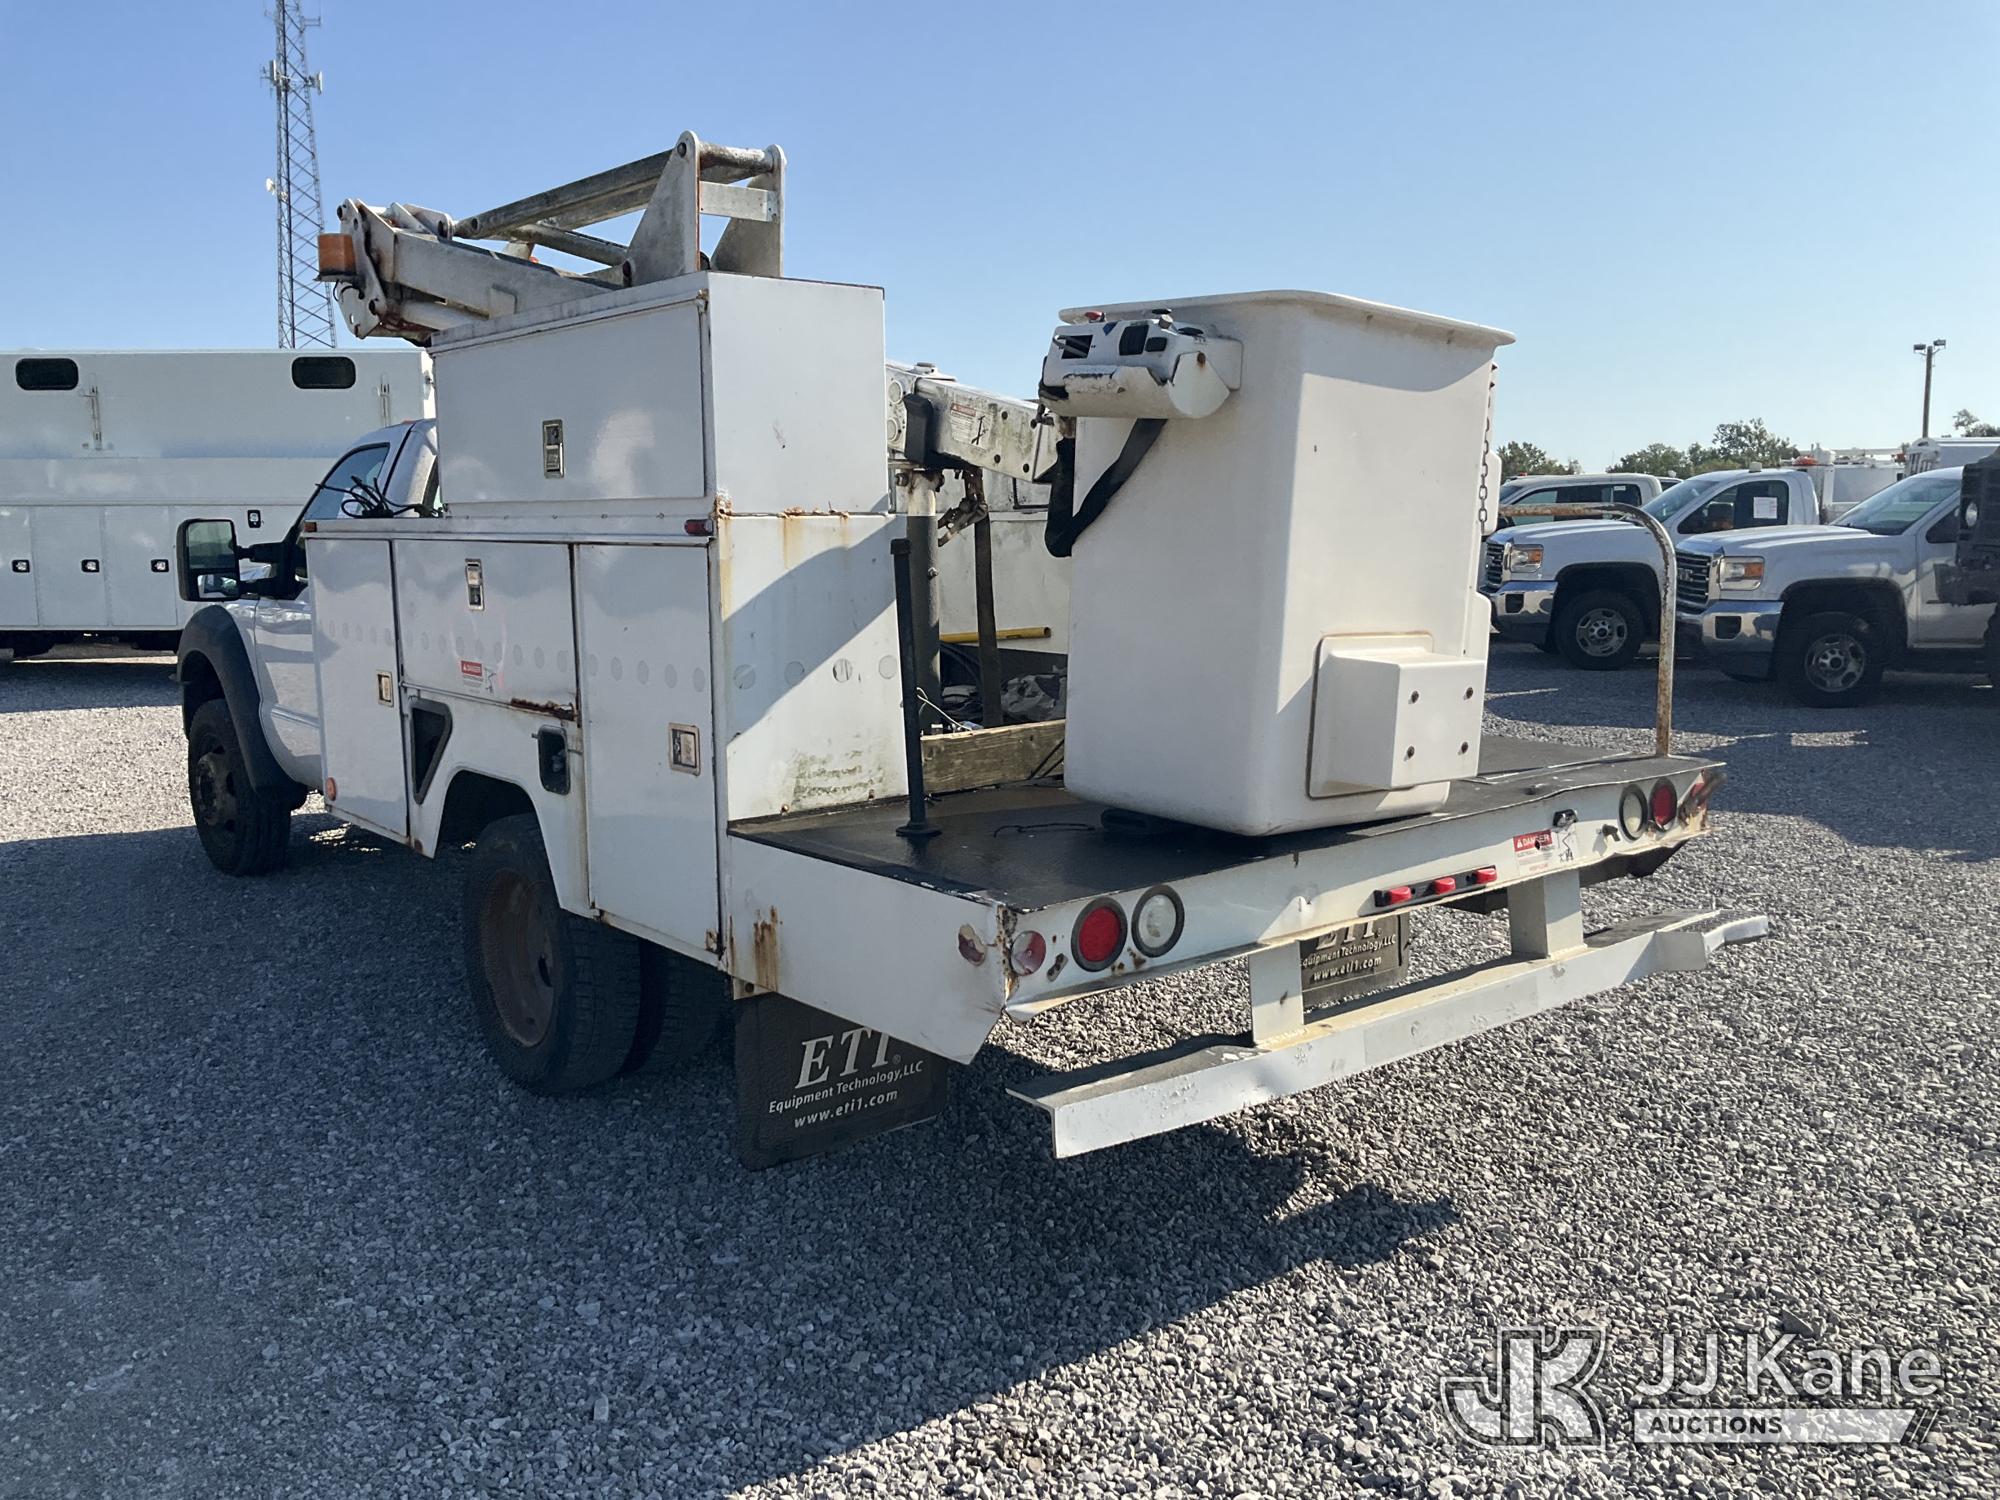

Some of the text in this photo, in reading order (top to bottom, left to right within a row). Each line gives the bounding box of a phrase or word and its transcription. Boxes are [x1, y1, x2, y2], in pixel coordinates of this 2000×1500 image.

[1302, 951, 1341, 967] quipment
[768, 1087, 834, 1114] Equipment
[793, 1089, 899, 1128] www.eti1.com
